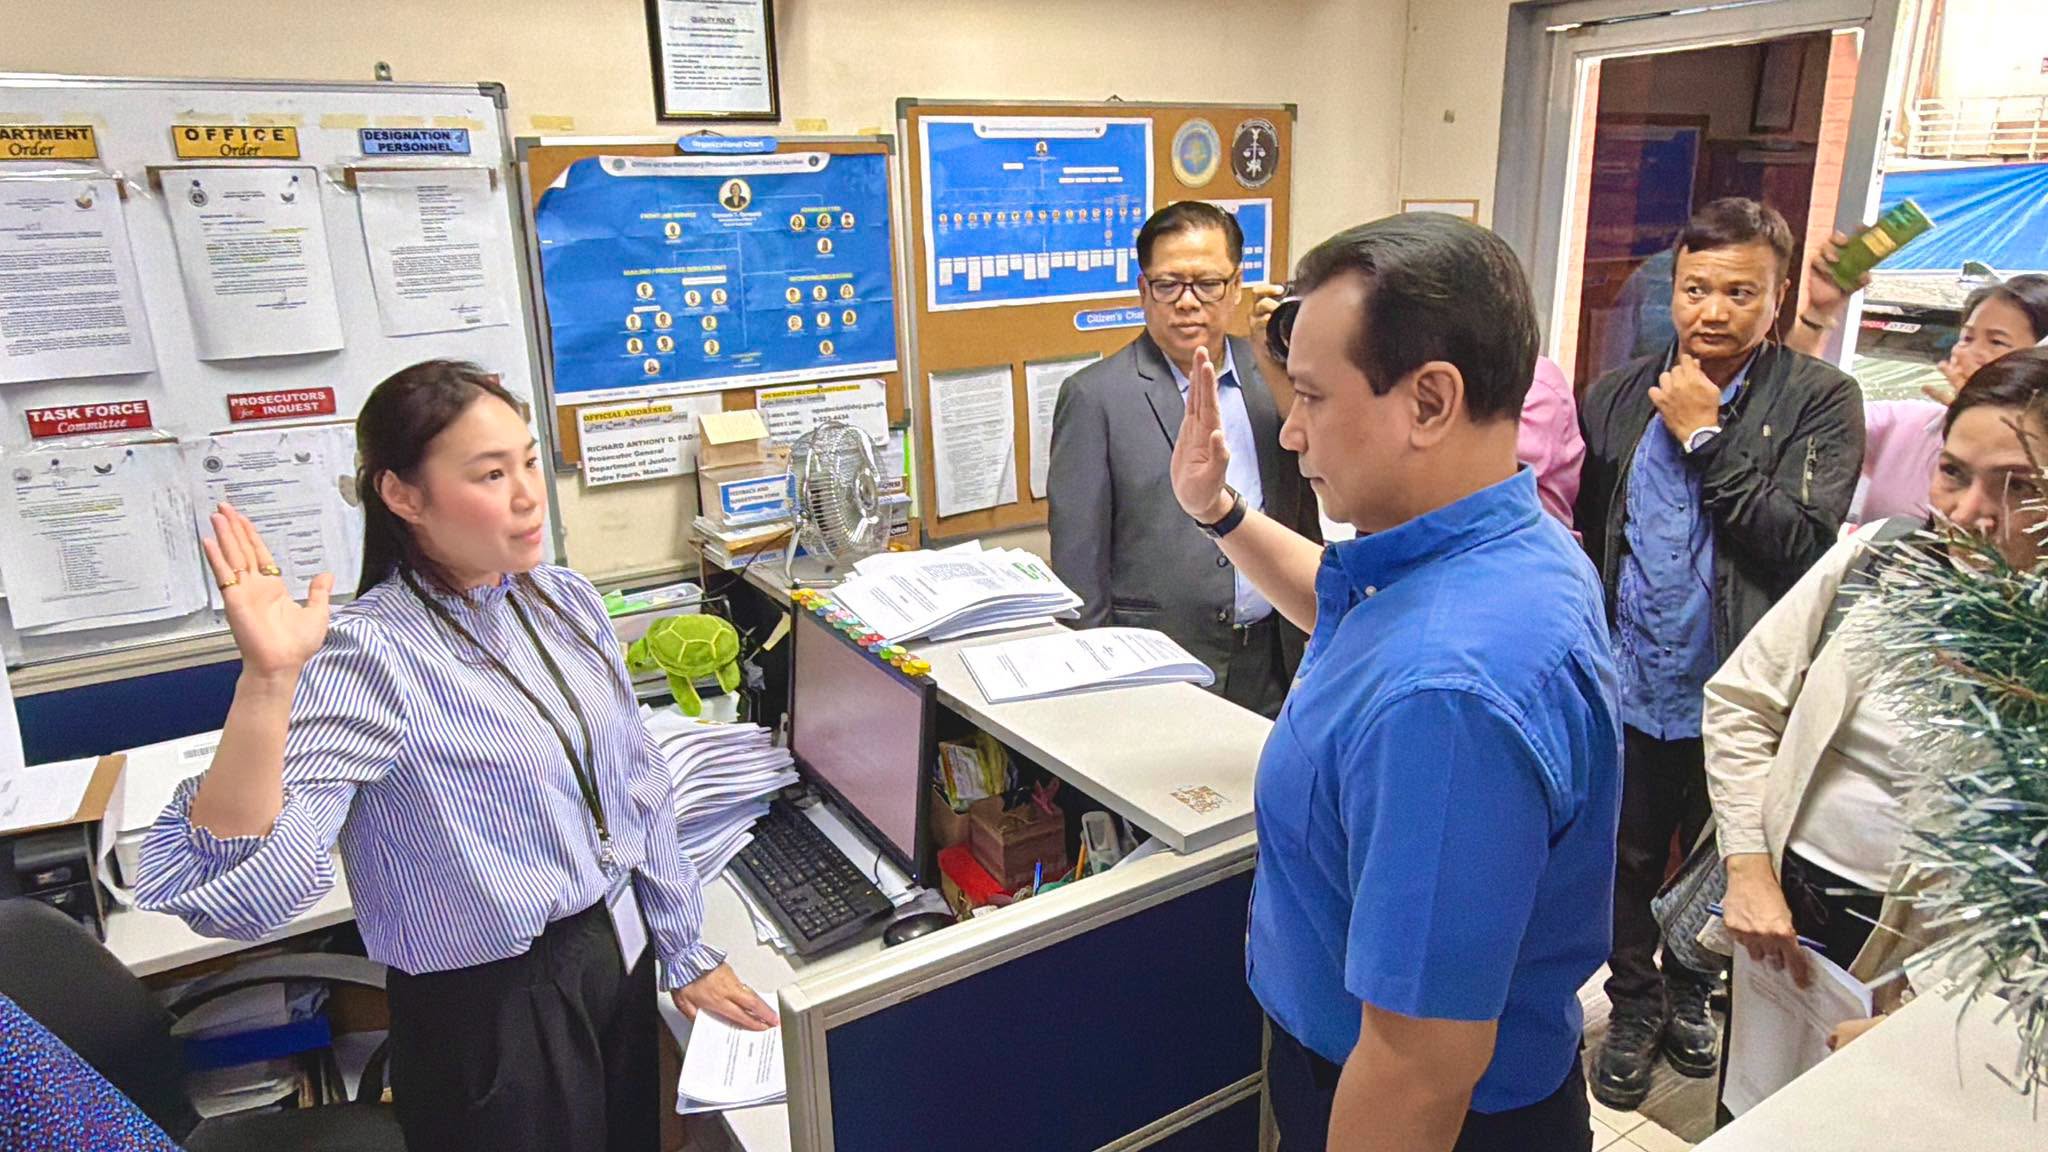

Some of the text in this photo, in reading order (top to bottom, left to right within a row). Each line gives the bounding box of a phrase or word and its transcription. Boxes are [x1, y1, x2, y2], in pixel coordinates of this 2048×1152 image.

[364, 131, 451, 141] DESIGNATION
[8, 141, 55, 156] Order
[220, 142, 260, 157] Order
[379, 142, 454, 152] PERSONNEL
[1086, 312, 1123, 324] Citizen's
[230, 391, 326, 407] PROSECUTORS
[29, 402, 146, 422] TASK FORCE
[262, 401, 320, 416] INQUEST
[583, 411, 623, 421] OFFICIAL
[57, 418, 128, 434] Committee
[587, 442, 624, 453] RICHARD
[626, 437, 665, 448] ANTHONY
[588, 447, 665, 462] Prosecutor General
[589, 461, 636, 473] Department
[648, 456, 677, 465] Justice
[590, 467, 668, 482] Padre Faura, Manila
